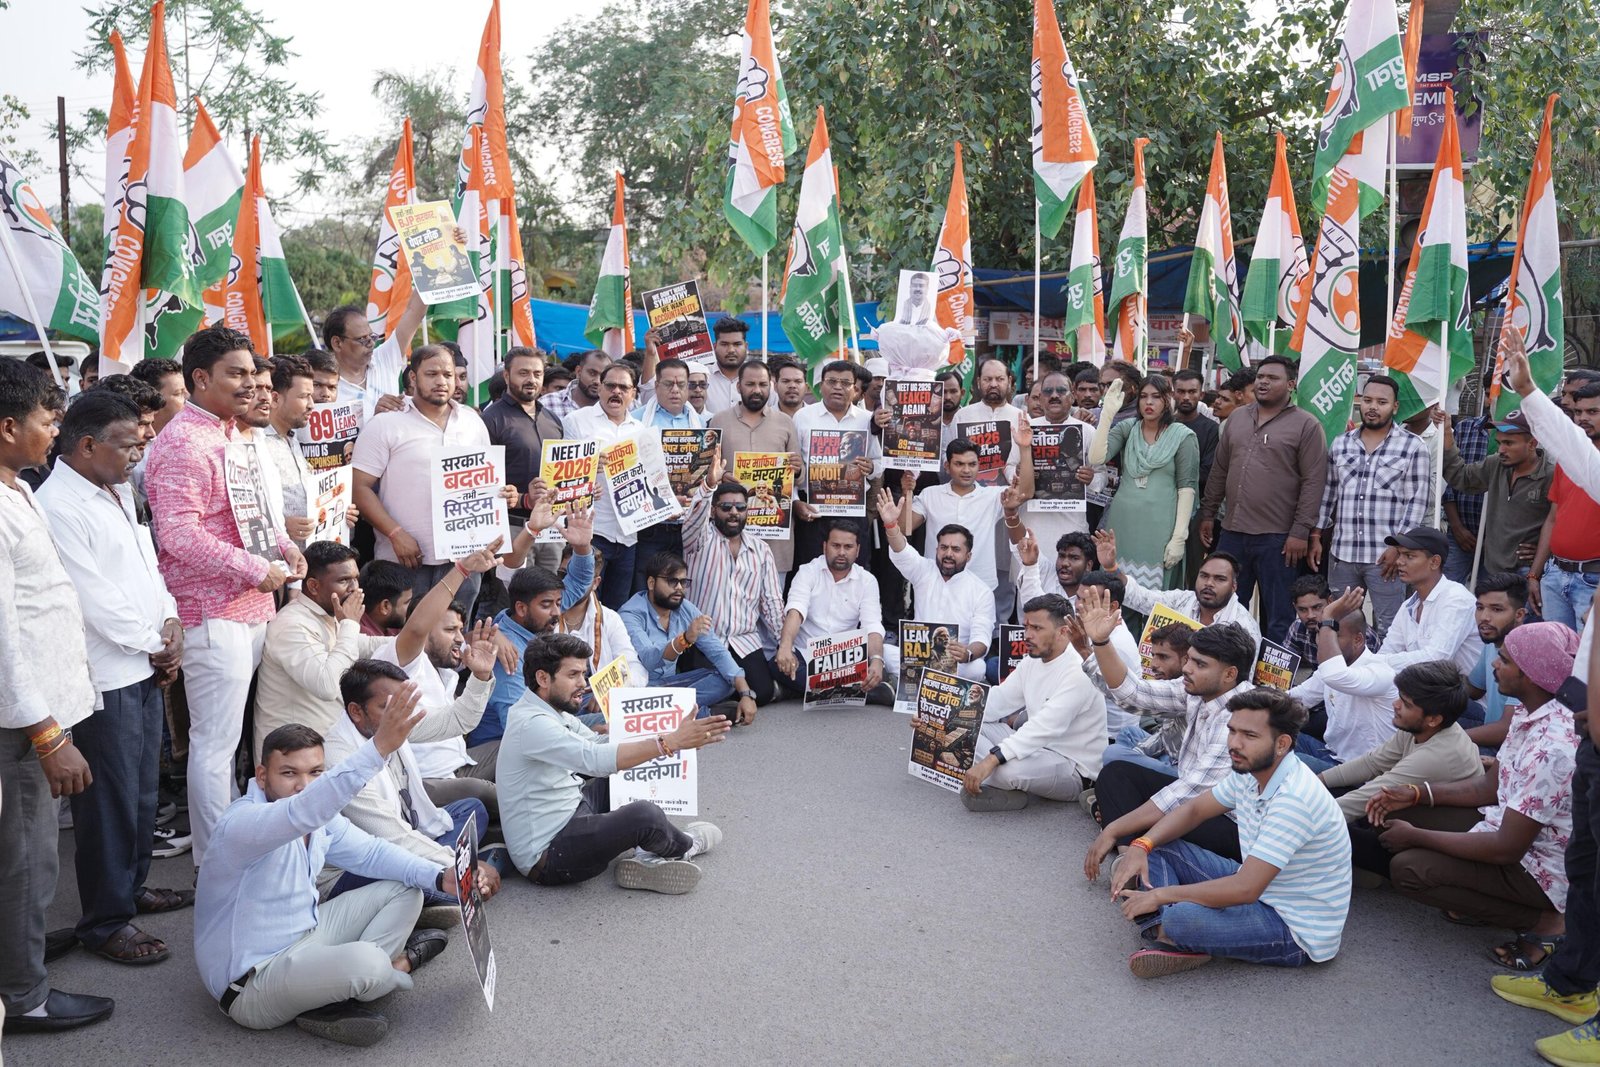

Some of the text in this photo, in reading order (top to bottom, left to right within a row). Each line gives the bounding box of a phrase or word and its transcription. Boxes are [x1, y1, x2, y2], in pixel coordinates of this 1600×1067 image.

[756, 106, 784, 168] CONGRESS
[398, 216, 414, 228] BJP
[408, 235, 424, 248] पेपर
[424, 230, 440, 242] लीक
[674, 284, 686, 294] WANT
[653, 290, 690, 308] SYMPATHY.
[670, 300, 685, 310] WANT
[667, 338, 687, 350] JUSTICE
[688, 335, 698, 343] FOR
[678, 349, 694, 358] NOW
[897, 383, 932, 392] NEET UG 2026
[898, 392, 931, 404] LEAKED
[902, 404, 926, 415] AGAIN
[309, 406, 350, 442] 89 PAPER
[334, 416, 356, 430] LEAKS
[966, 422, 997, 436] NEET UG
[811, 437, 840, 446] PAPER
[898, 439, 908, 450] 89
[1032, 431, 1059, 446] लीक
[302, 444, 328, 458] WHO IS
[552, 442, 596, 461] NEET UG
[662, 442, 699, 453] पेपर लीक
[810, 447, 840, 456] LEAK
[1033, 446, 1060, 458] राज
[308, 454, 342, 470] ESPONSIBLE
[442, 452, 486, 472] सरकार
[553, 456, 592, 480] 2026
[608, 459, 625, 476] राज
[737, 455, 777, 469] पेपर माफिया
[444, 462, 500, 490] बदलो,
[612, 462, 646, 486] खत्म करो,
[740, 471, 751, 480] कौन
[810, 468, 840, 480] MODI!
[318, 472, 338, 495] NEET
[462, 490, 476, 500] तभी
[617, 490, 645, 515] न्याय
[443, 496, 494, 518] सिस्टम
[444, 509, 500, 532] बदलेगा!
[903, 630, 930, 643] LEAK
[813, 636, 863, 658] GOVERNMENT
[904, 642, 931, 658] RAJ
[814, 646, 863, 674] FAILED
[1262, 652, 1290, 670] SYMPATHY.
[820, 666, 856, 682] AN ENTIRE
[1264, 663, 1284, 677] WE WANT
[594, 665, 619, 698] NEET UG
[940, 683, 959, 694] सरकार
[622, 694, 674, 714] सरकार
[921, 686, 960, 707] पेपर लीक
[623, 760, 688, 782] बदलेगा!
